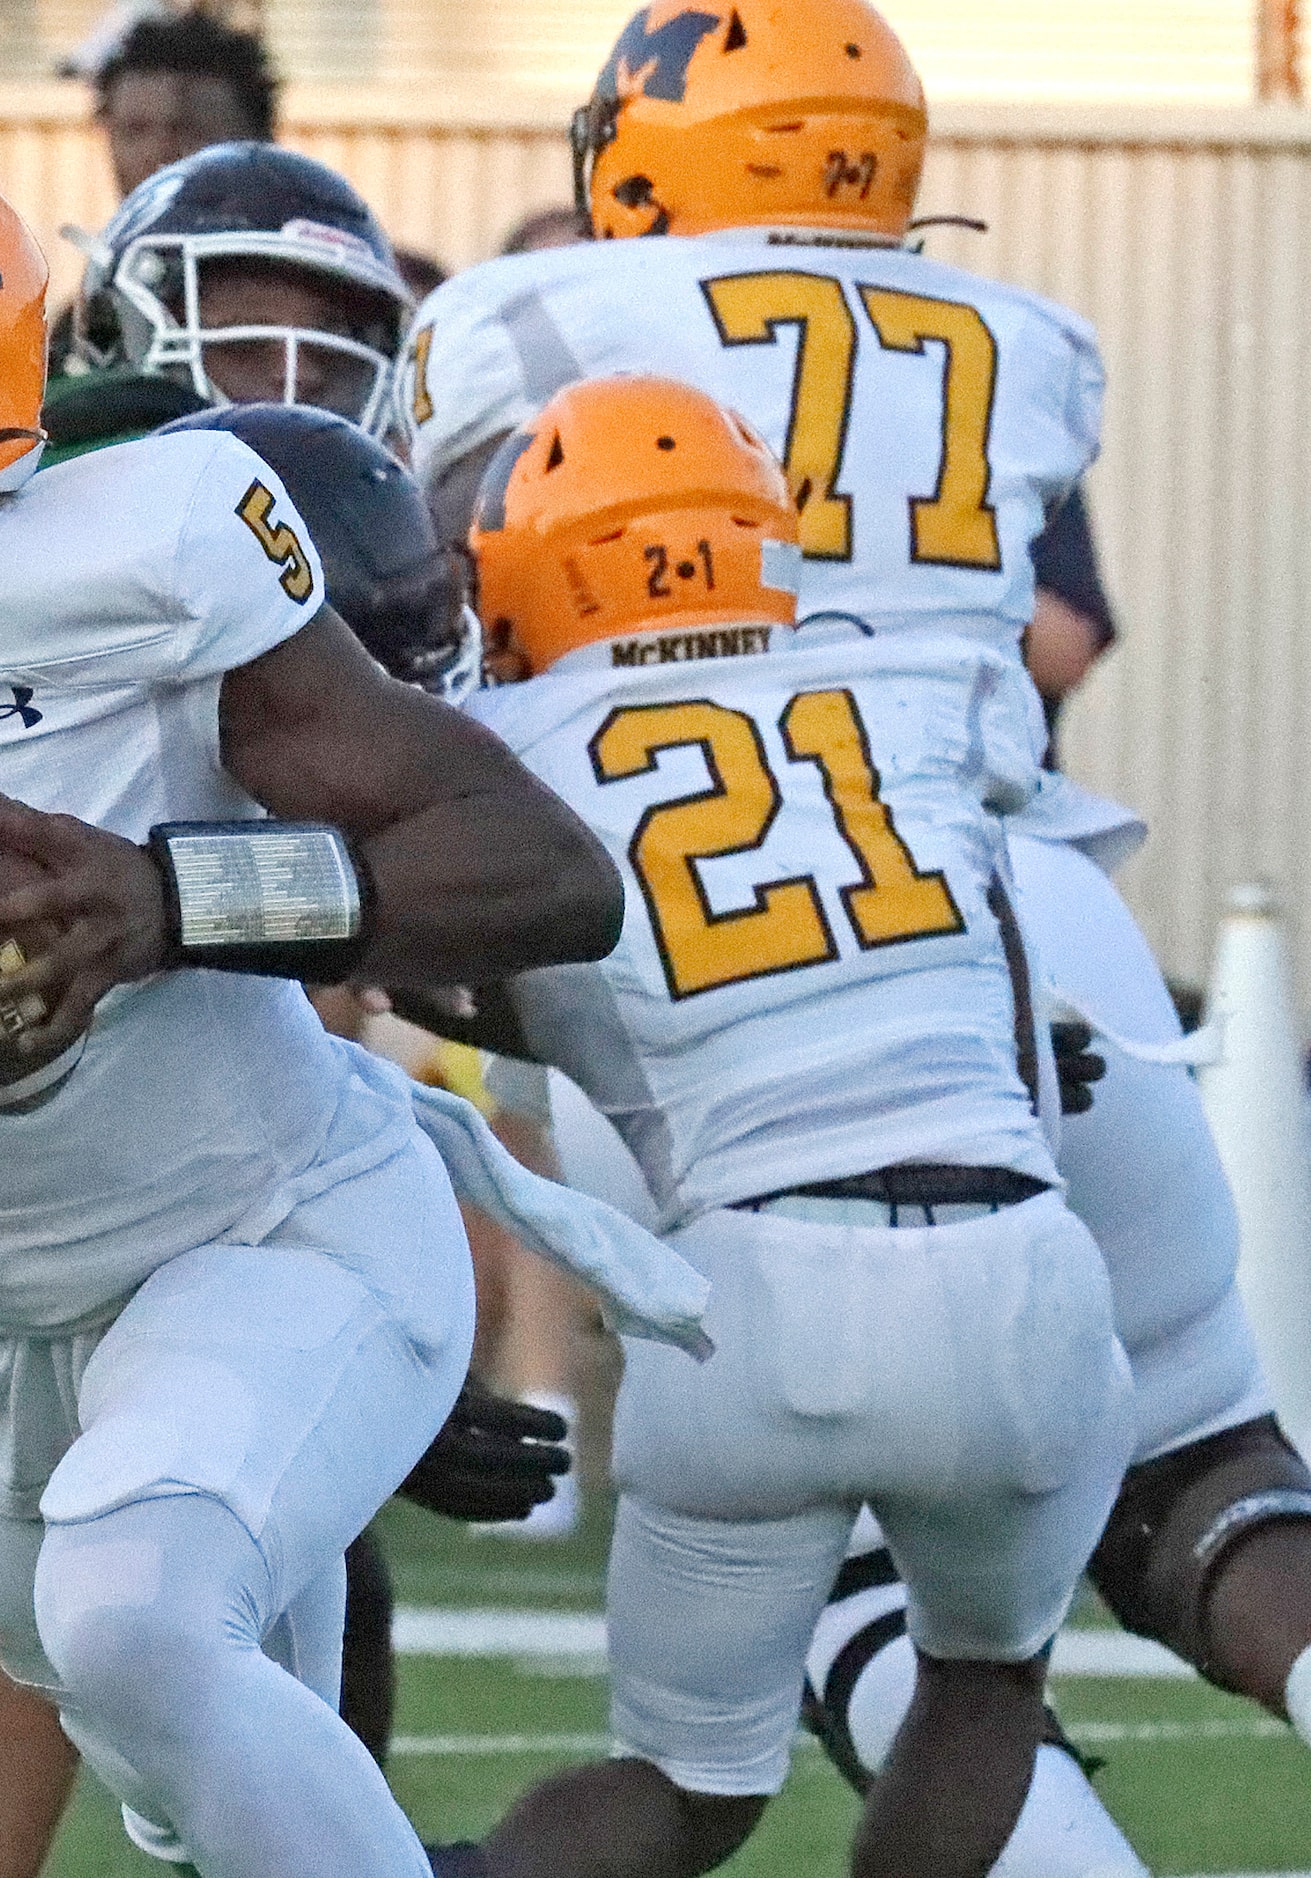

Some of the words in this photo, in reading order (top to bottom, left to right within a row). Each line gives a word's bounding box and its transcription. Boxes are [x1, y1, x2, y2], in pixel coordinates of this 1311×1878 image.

[699, 268, 1002, 574] 77
[233, 476, 315, 606] 5
[611, 625, 772, 668] McKINNEY
[586, 687, 967, 1004] 21
